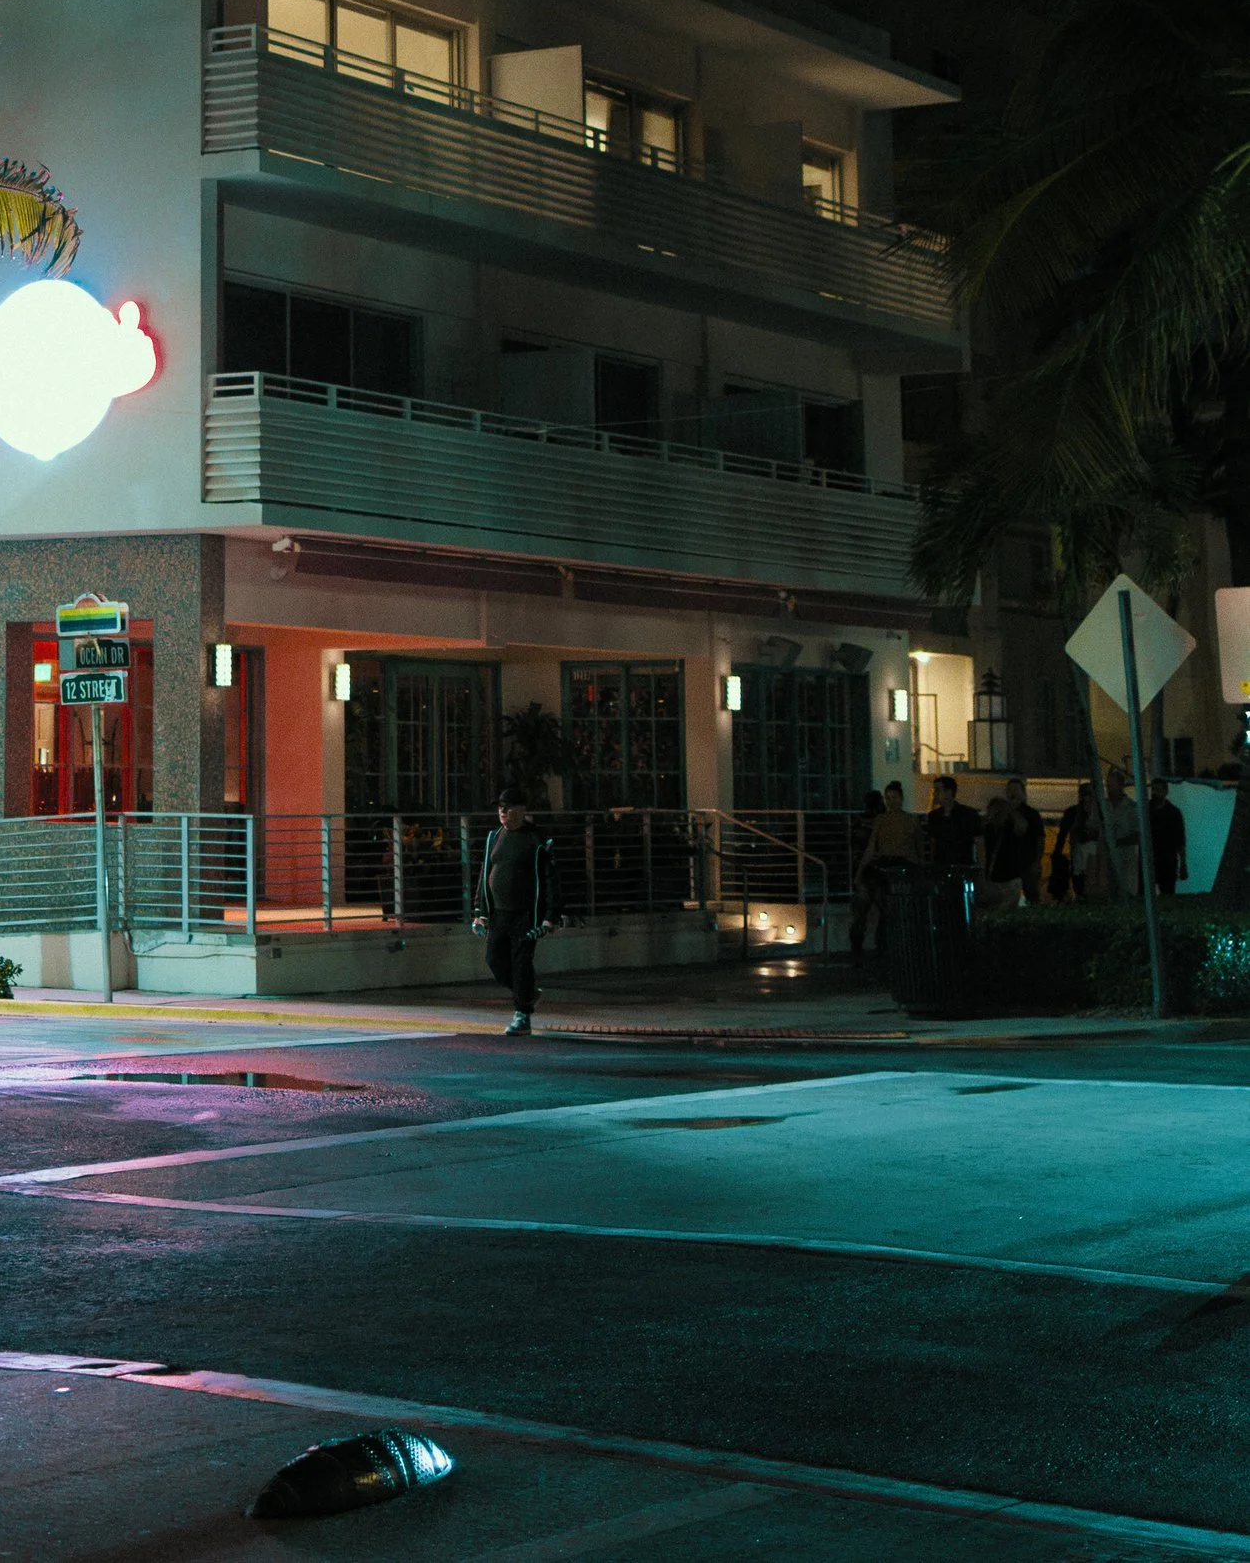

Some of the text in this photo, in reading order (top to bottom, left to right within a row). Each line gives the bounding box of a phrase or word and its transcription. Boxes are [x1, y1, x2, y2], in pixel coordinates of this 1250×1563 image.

[111, 646, 125, 664] DR
[65, 679, 118, 700] 12 STREET
